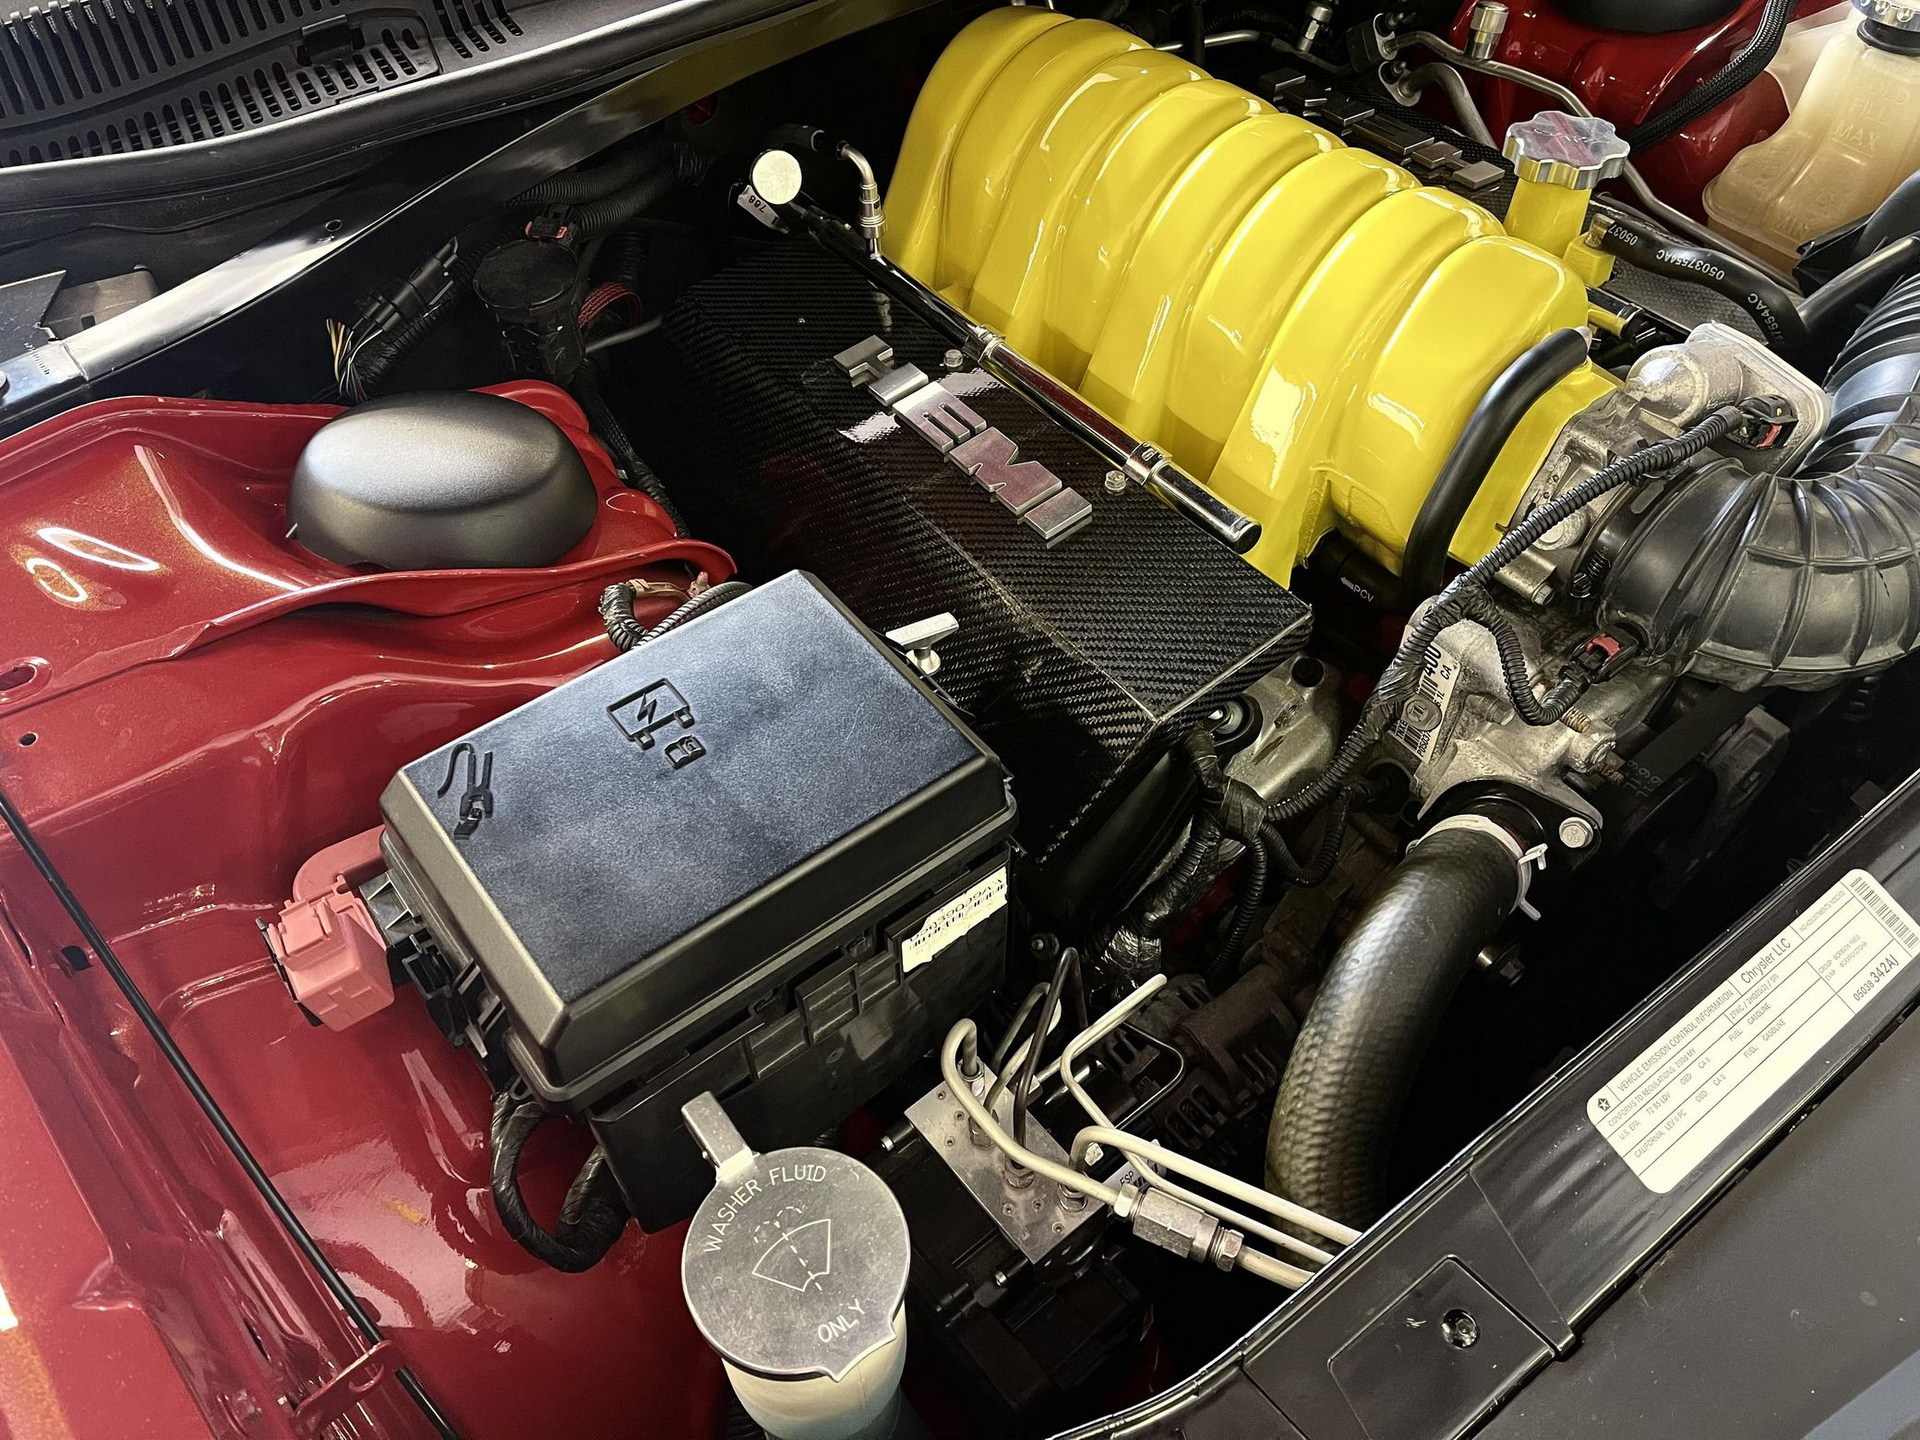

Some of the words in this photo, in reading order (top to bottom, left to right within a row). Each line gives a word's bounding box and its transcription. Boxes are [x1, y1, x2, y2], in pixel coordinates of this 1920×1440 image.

[1833, 120, 1879, 152] MAX
[1656, 249, 1725, 281] 05037554AC
[833, 334, 1092, 540] HEMI
[1353, 584, 1375, 603] PCV
[1440, 664, 1453, 681] CA
[1740, 952, 1775, 983] Chrysler
[1771, 937, 1791, 956] LLC
[1852, 979, 1874, 1001] 05038
[1869, 953, 1899, 983] 342AJ
[1746, 1001, 1771, 1025] GASOLINE
[1616, 1066, 1644, 1091] VEHICLE
[1640, 1043, 1671, 1071] EMISSION
[1668, 1021, 1697, 1047] CONTROL
[1694, 988, 1734, 1024] INFORMATION
[1607, 1099, 1637, 1127] CONFORMS
[1633, 1093, 1644, 1103] TO
[1685, 1047, 1696, 1058] MY
[1663, 1118, 1675, 1131] LEV
[1761, 1018, 1786, 1041] GASOLINE
[703, 1178, 763, 1253] WASHER
[768, 1163, 827, 1187] FLUID
[817, 1298, 866, 1344] ONLY
